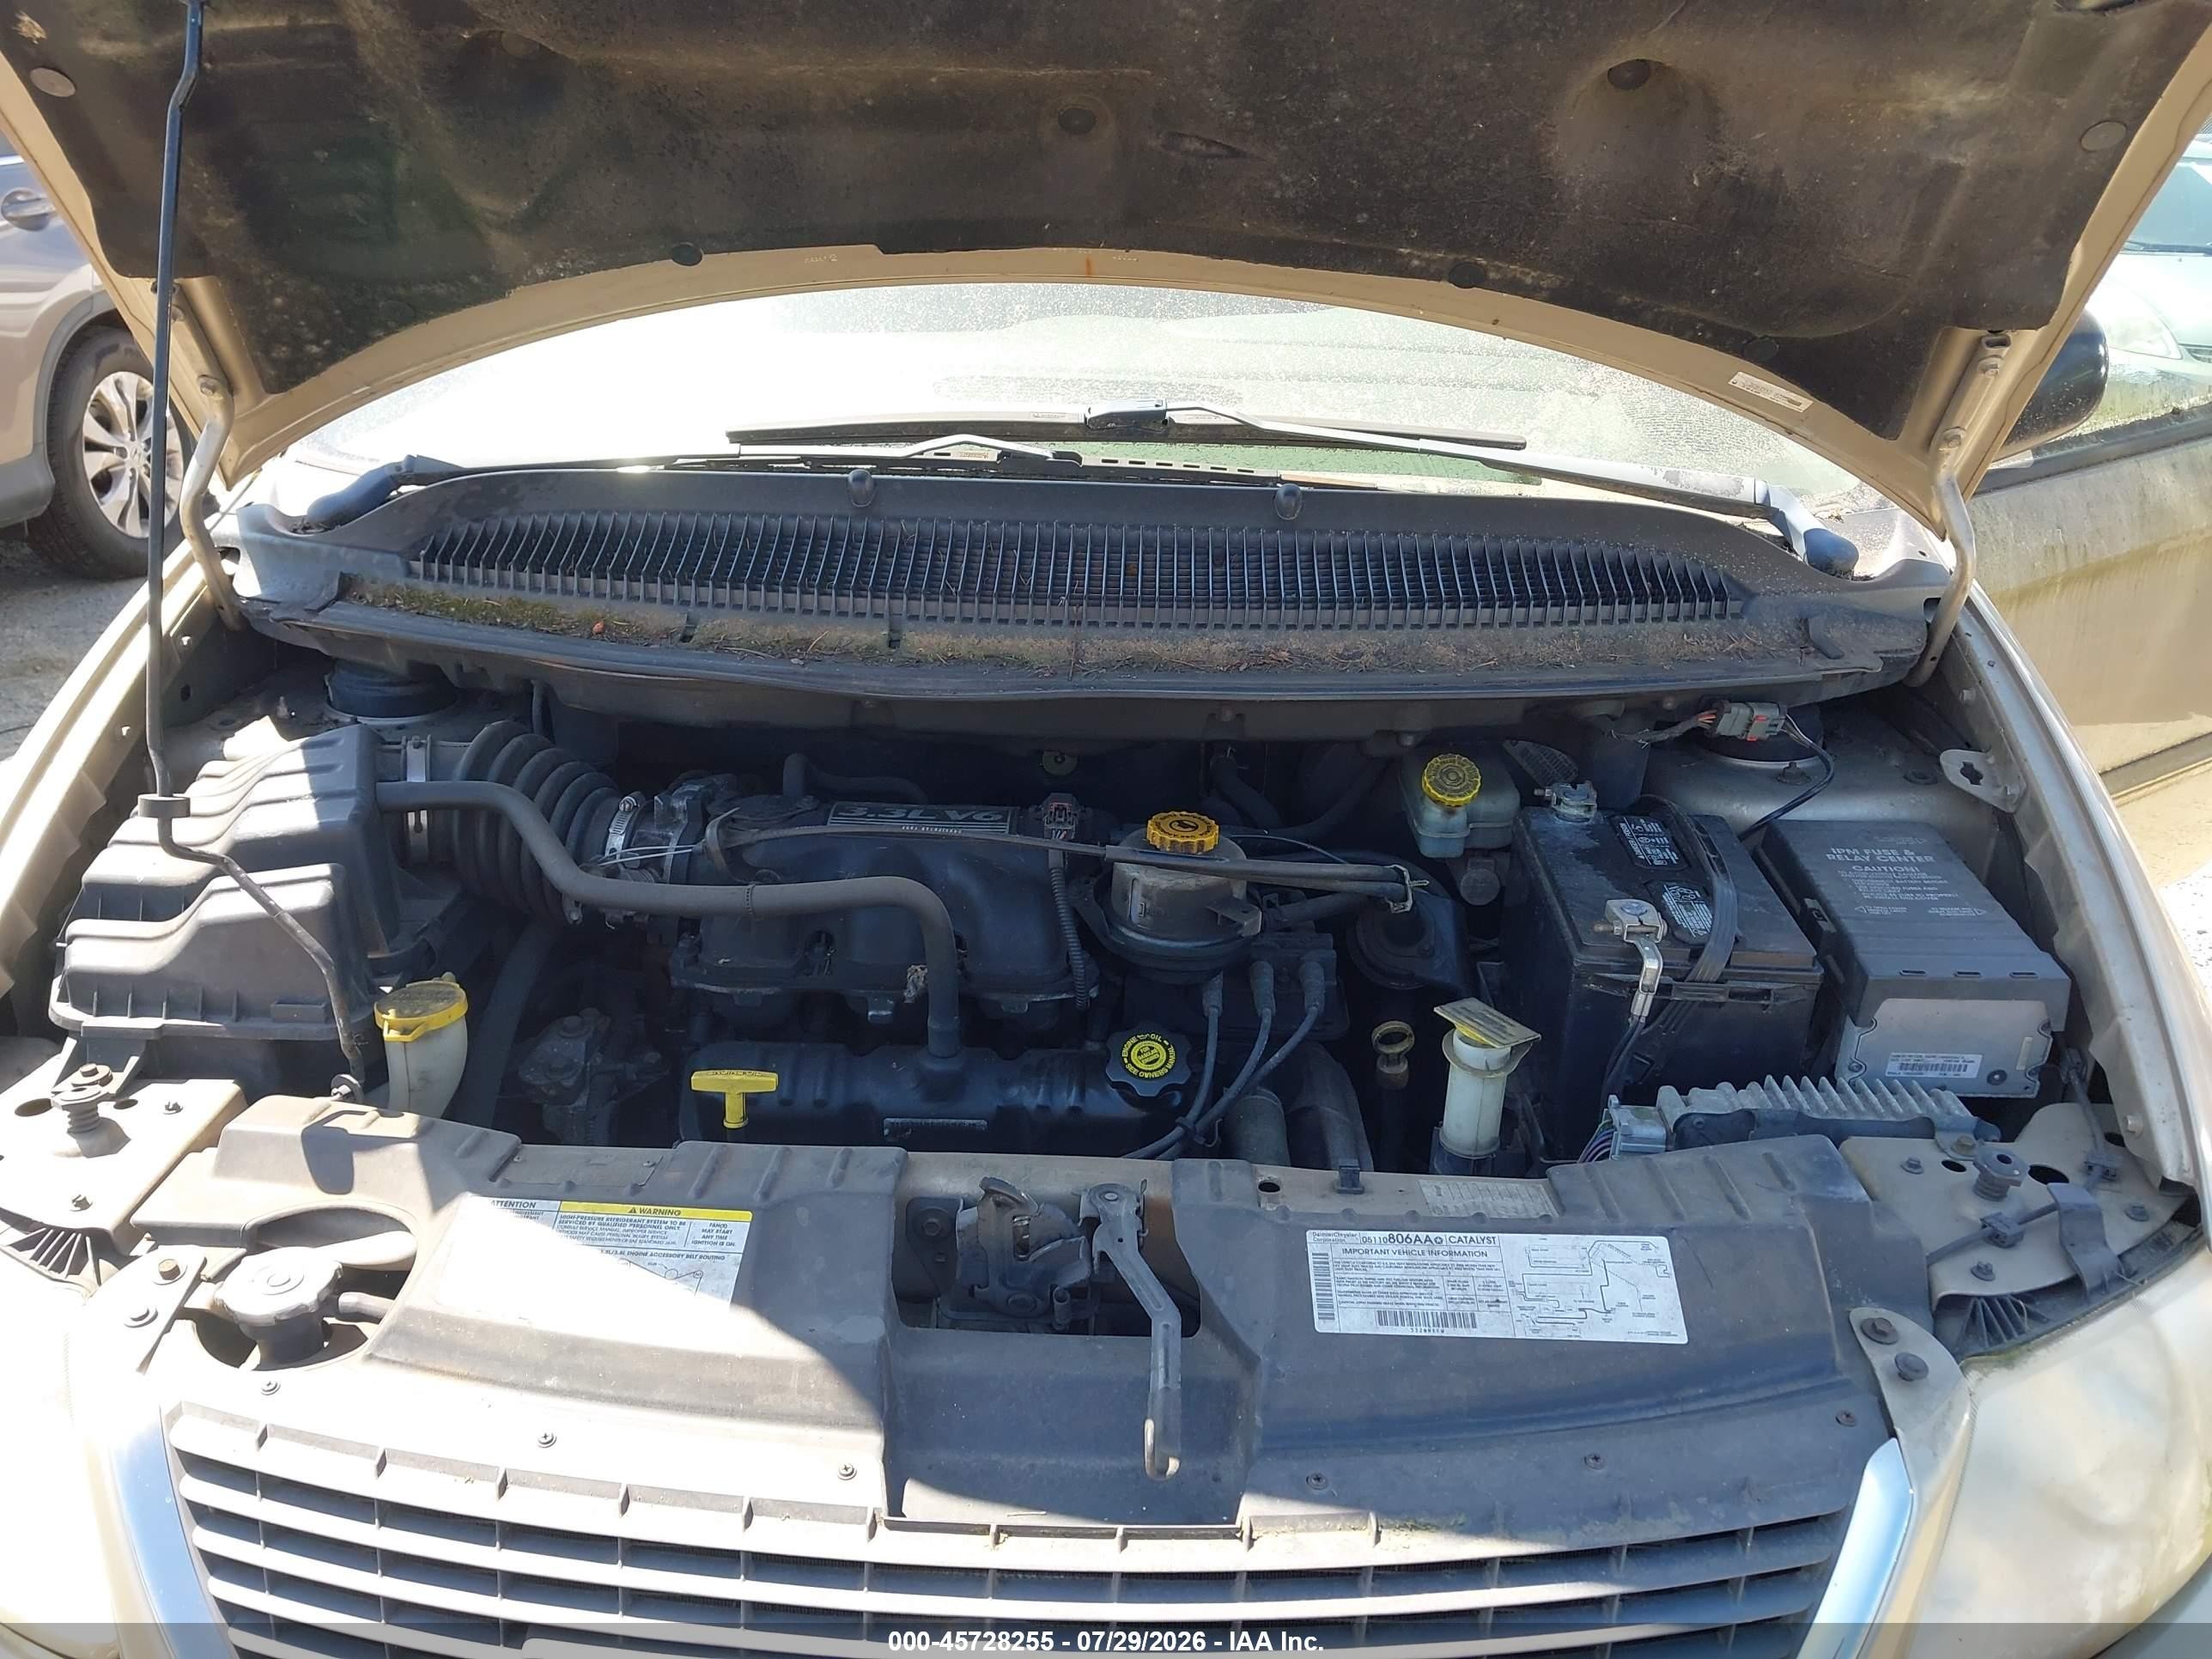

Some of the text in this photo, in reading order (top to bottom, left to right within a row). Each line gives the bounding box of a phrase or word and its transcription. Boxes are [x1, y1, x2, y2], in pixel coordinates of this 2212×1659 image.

[838, 806, 1005, 821] 3.3L V6
[1151, 1033, 1162, 1042] OIL
[639, 1207, 682, 1217] WARNING
[1448, 1236, 1497, 1245] CATALYST
[1342, 1248, 1390, 1256] IMPORTANT
[1428, 1249, 1488, 1258] INFORMATION
